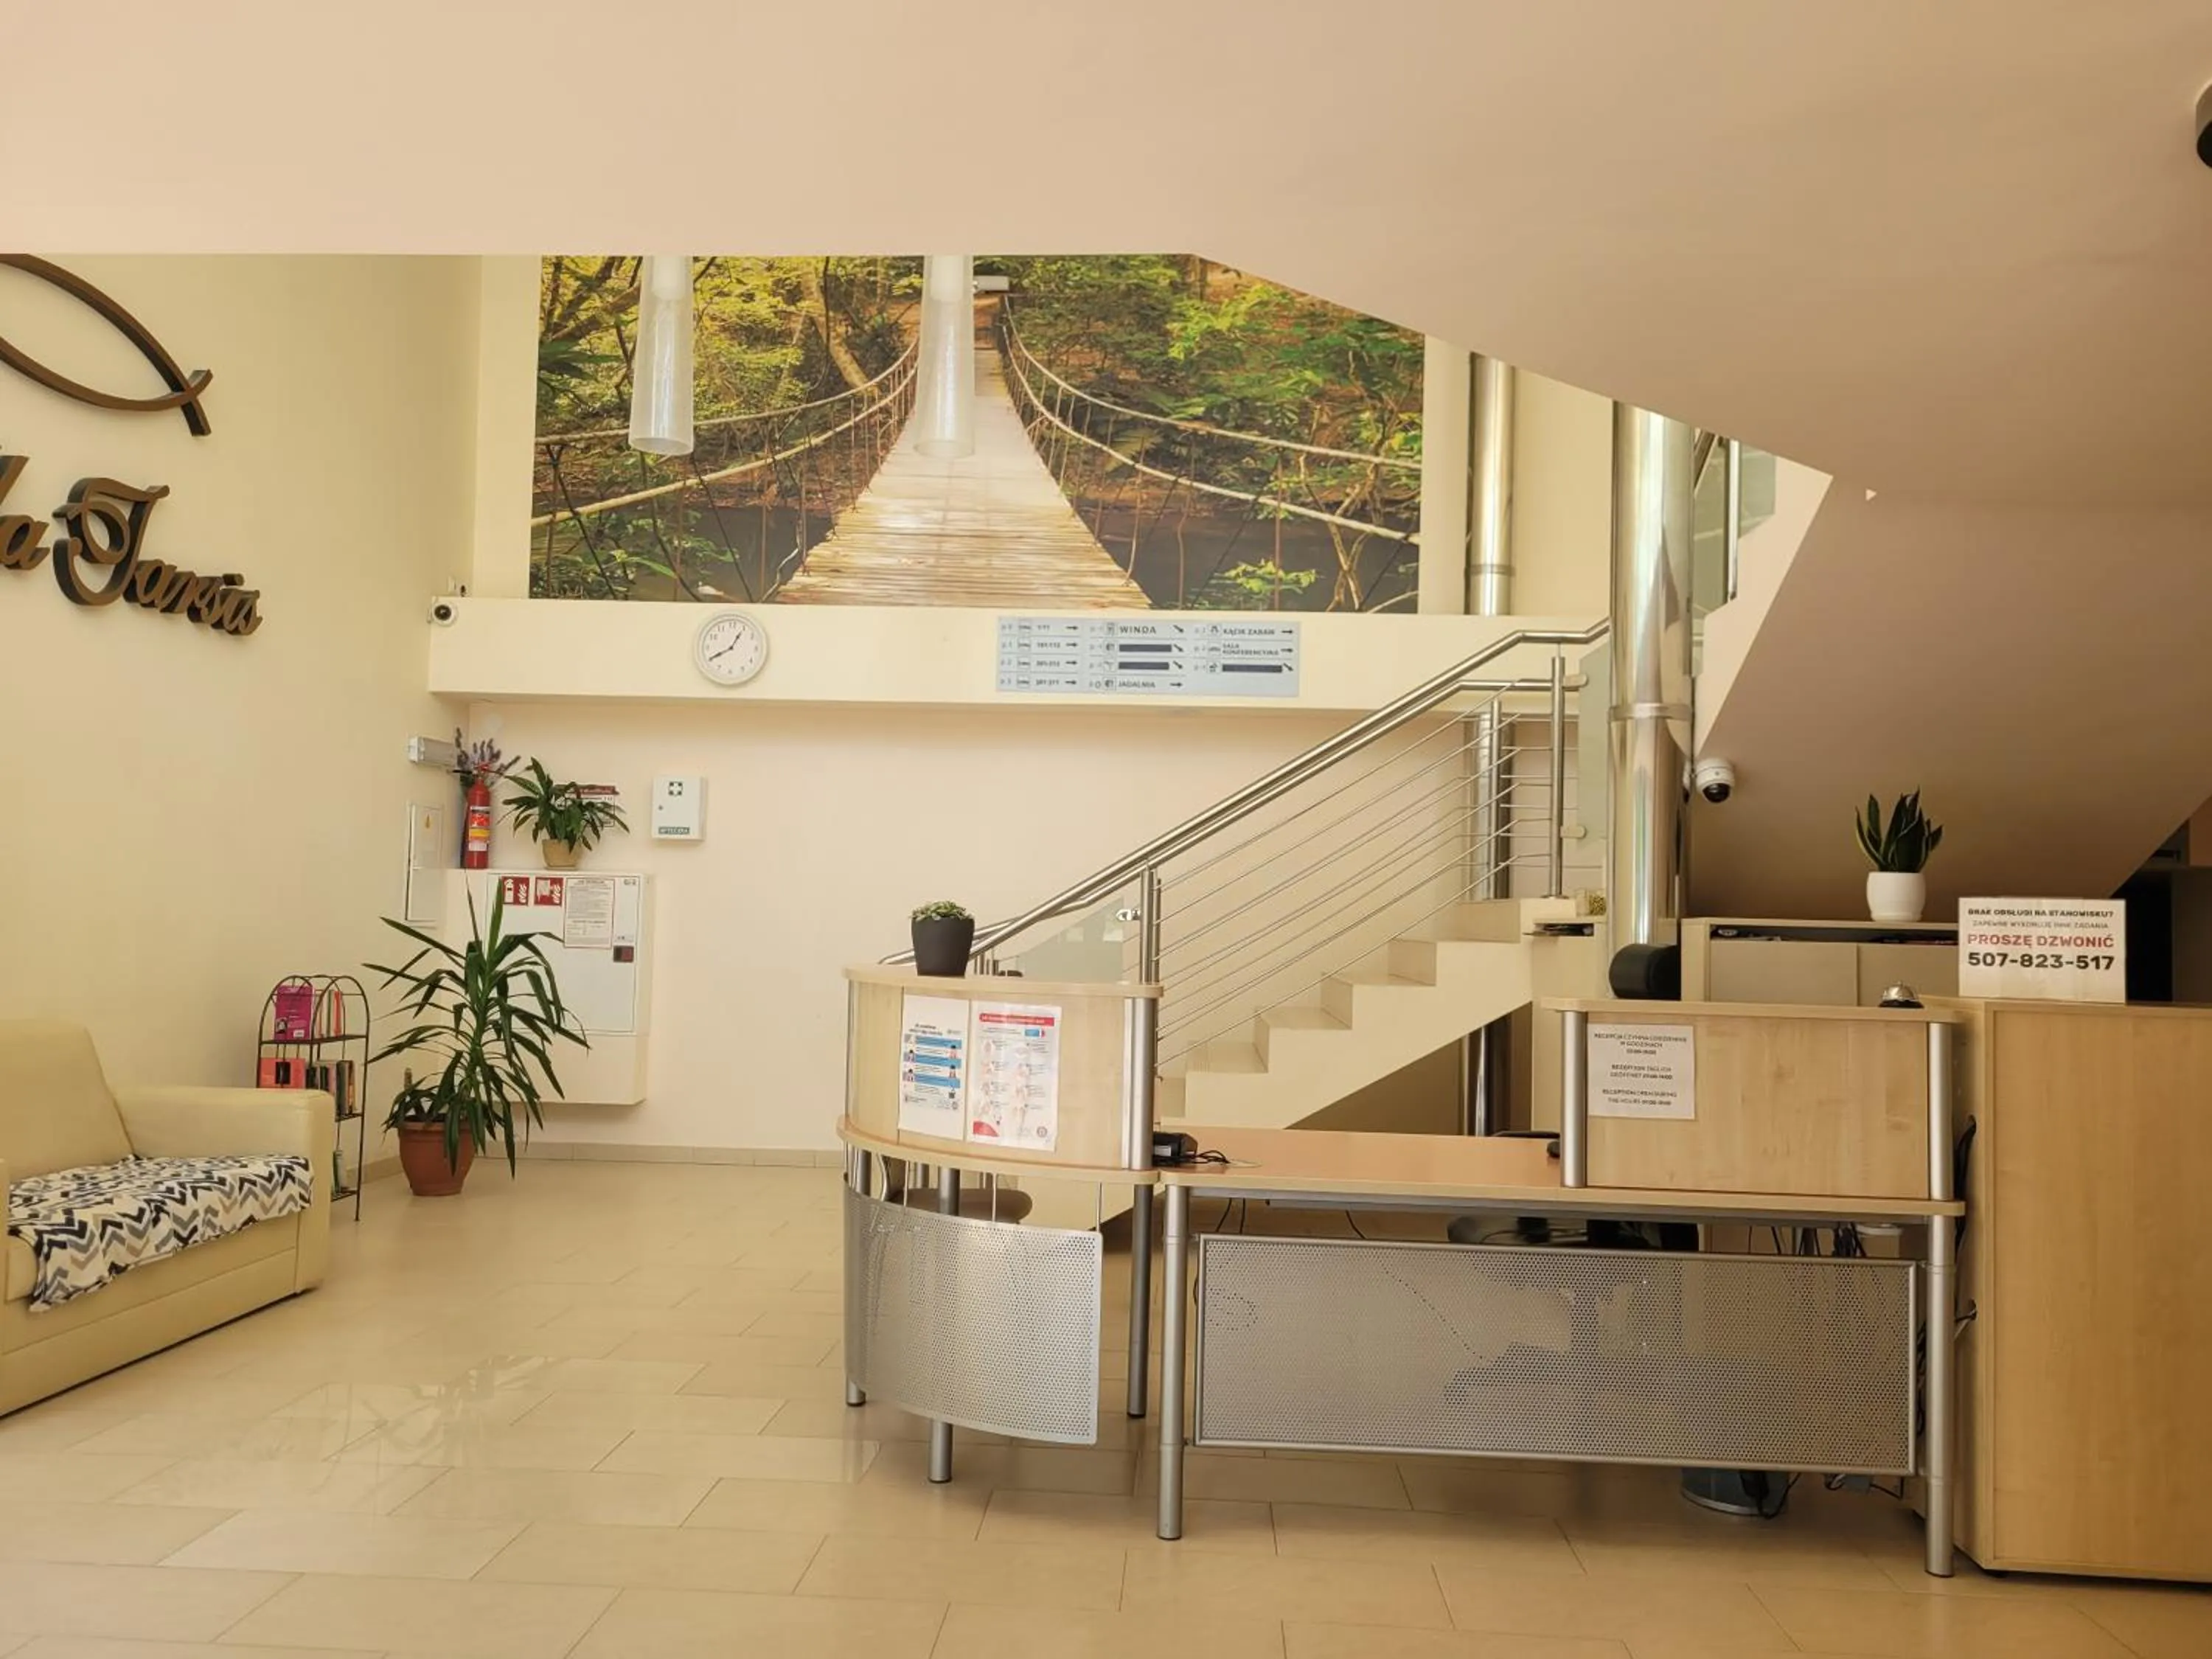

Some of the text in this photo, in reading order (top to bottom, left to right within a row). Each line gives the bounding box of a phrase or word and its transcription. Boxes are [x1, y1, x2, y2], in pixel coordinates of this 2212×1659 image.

[1119, 625, 1156, 634] WINDA
[1968, 933, 2114, 948] PROSZĘ DZWONIĆ
[1968, 952, 2115, 970] 507-823-517
